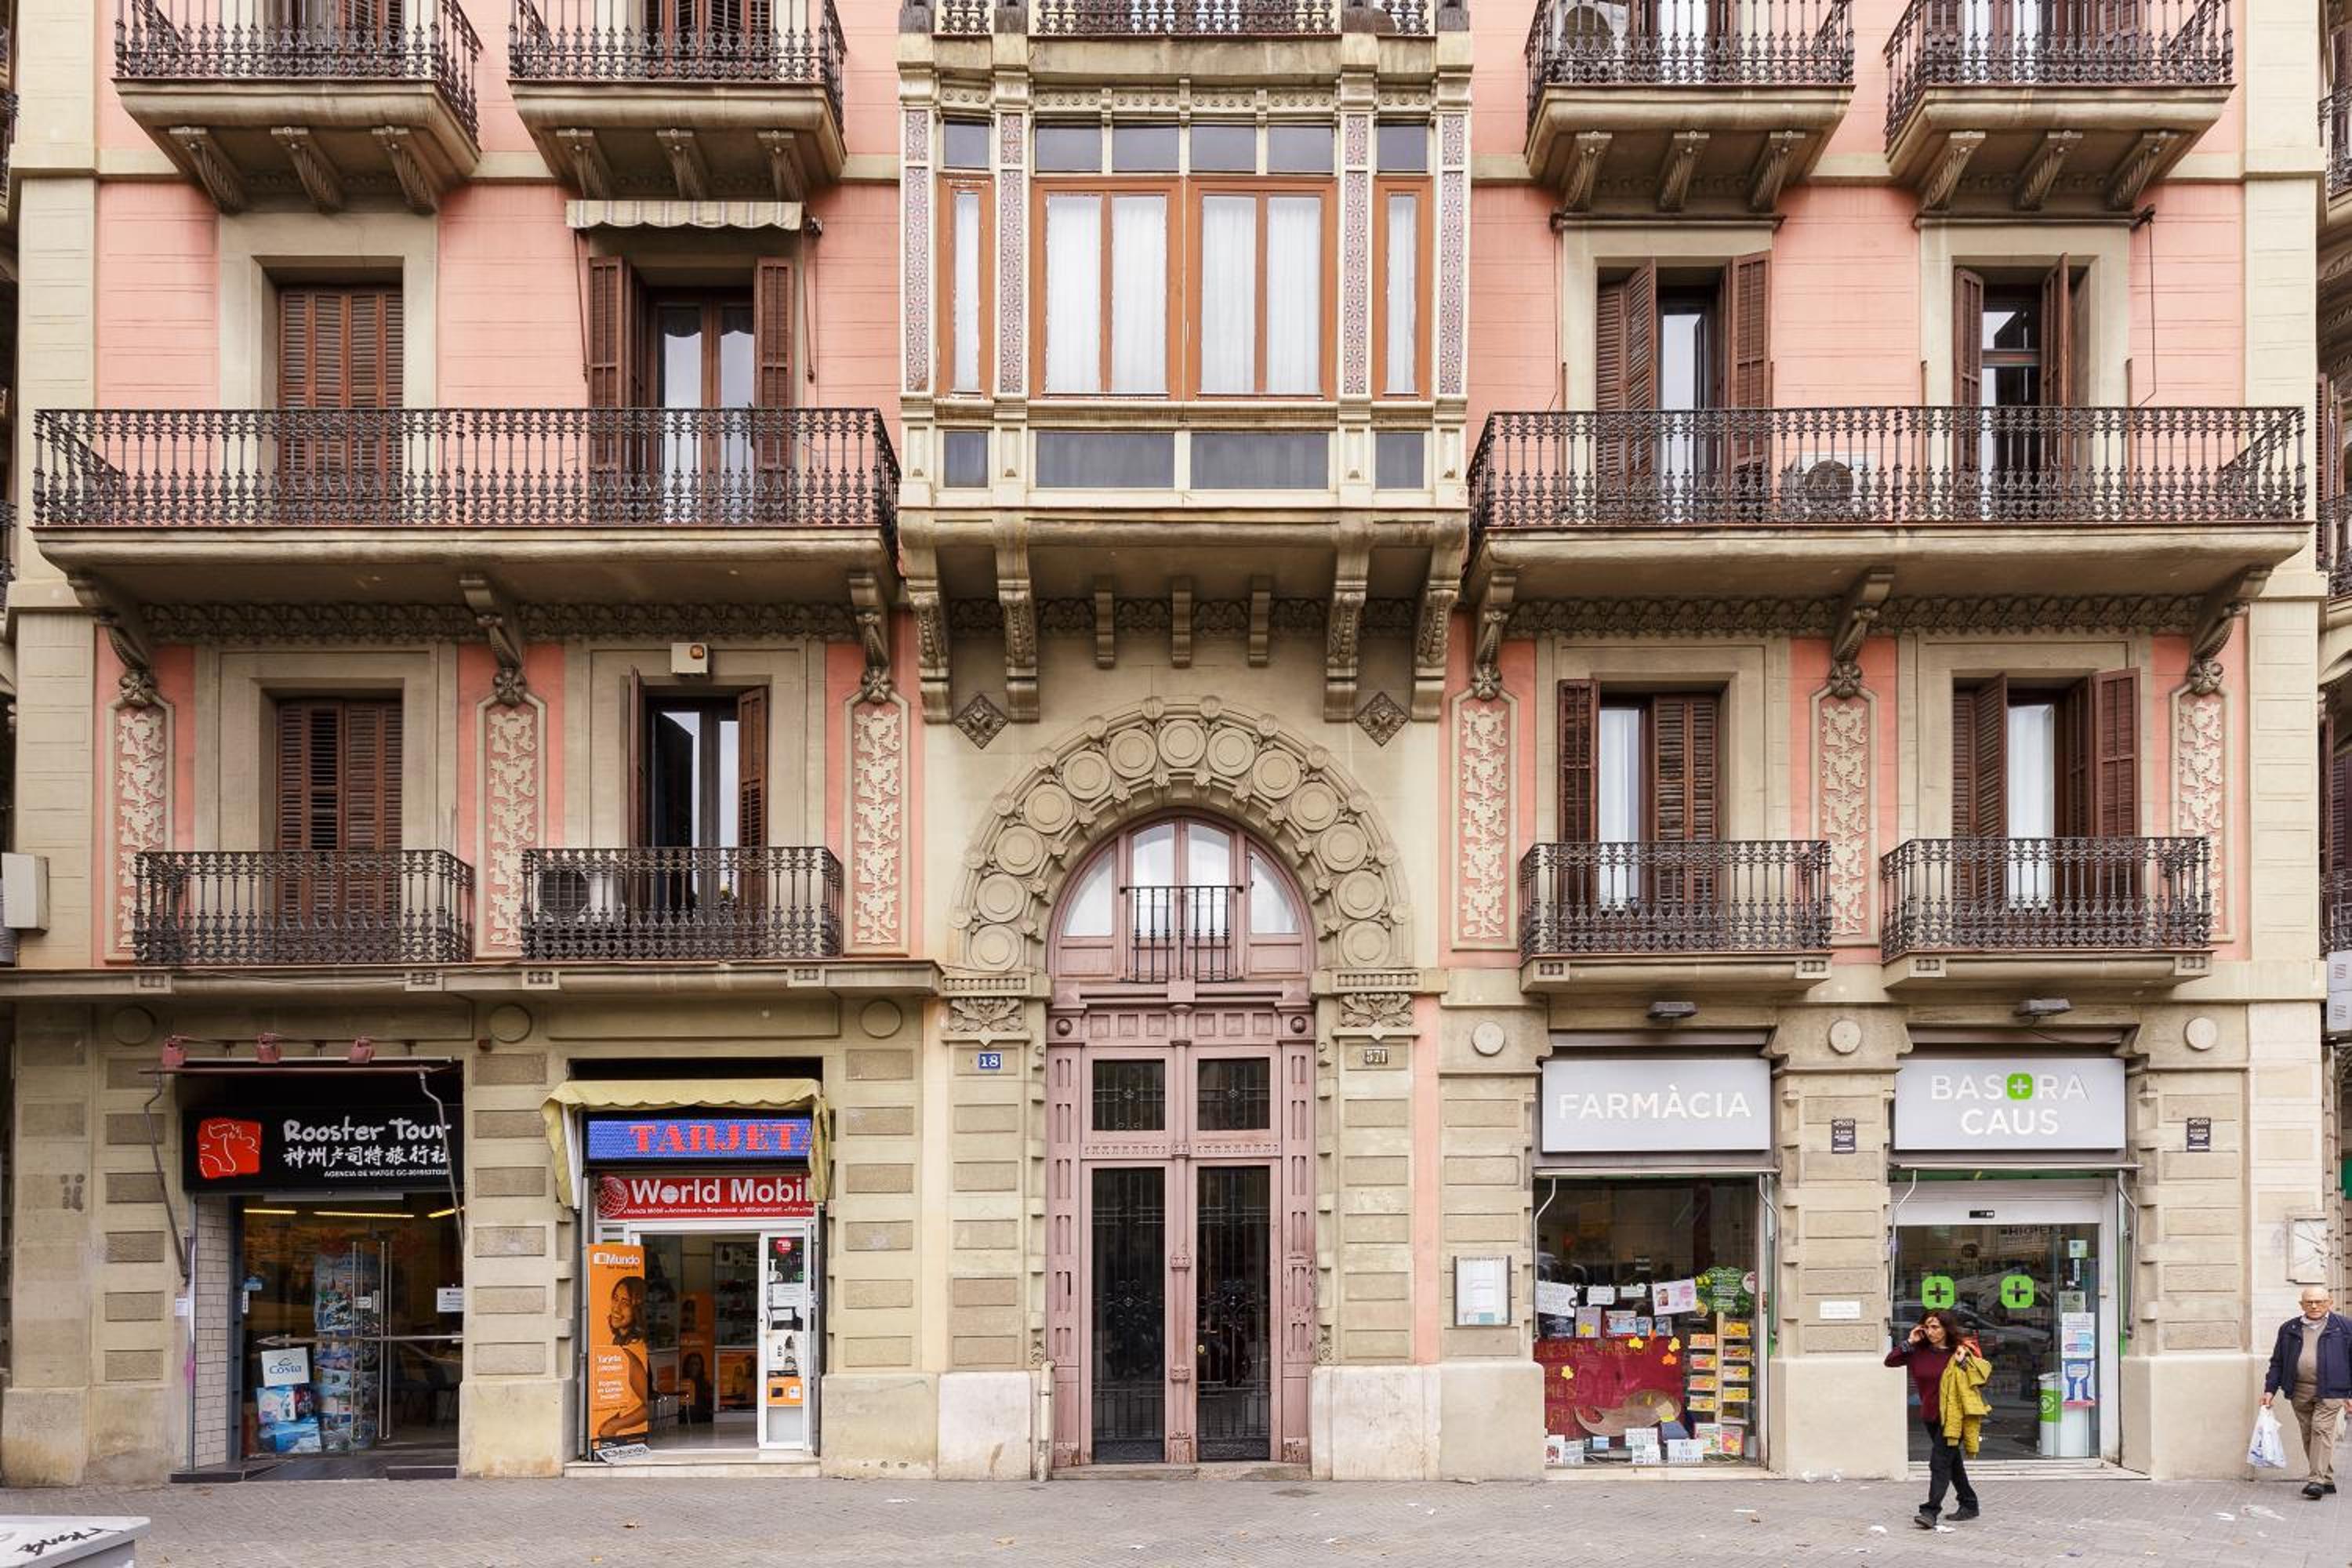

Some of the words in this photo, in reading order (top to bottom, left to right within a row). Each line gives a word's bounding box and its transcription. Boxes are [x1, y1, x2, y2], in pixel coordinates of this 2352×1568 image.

[982, 1055, 999, 1067] 18
[1559, 1083, 1752, 1120] FARMÀCIA
[283, 1116, 386, 1142] Rooster
[389, 1117, 452, 1141] Tour
[1961, 1108, 2060, 1135] CAUS
[631, 1175, 721, 1204] World
[607, 1254, 640, 1265] Mundo
